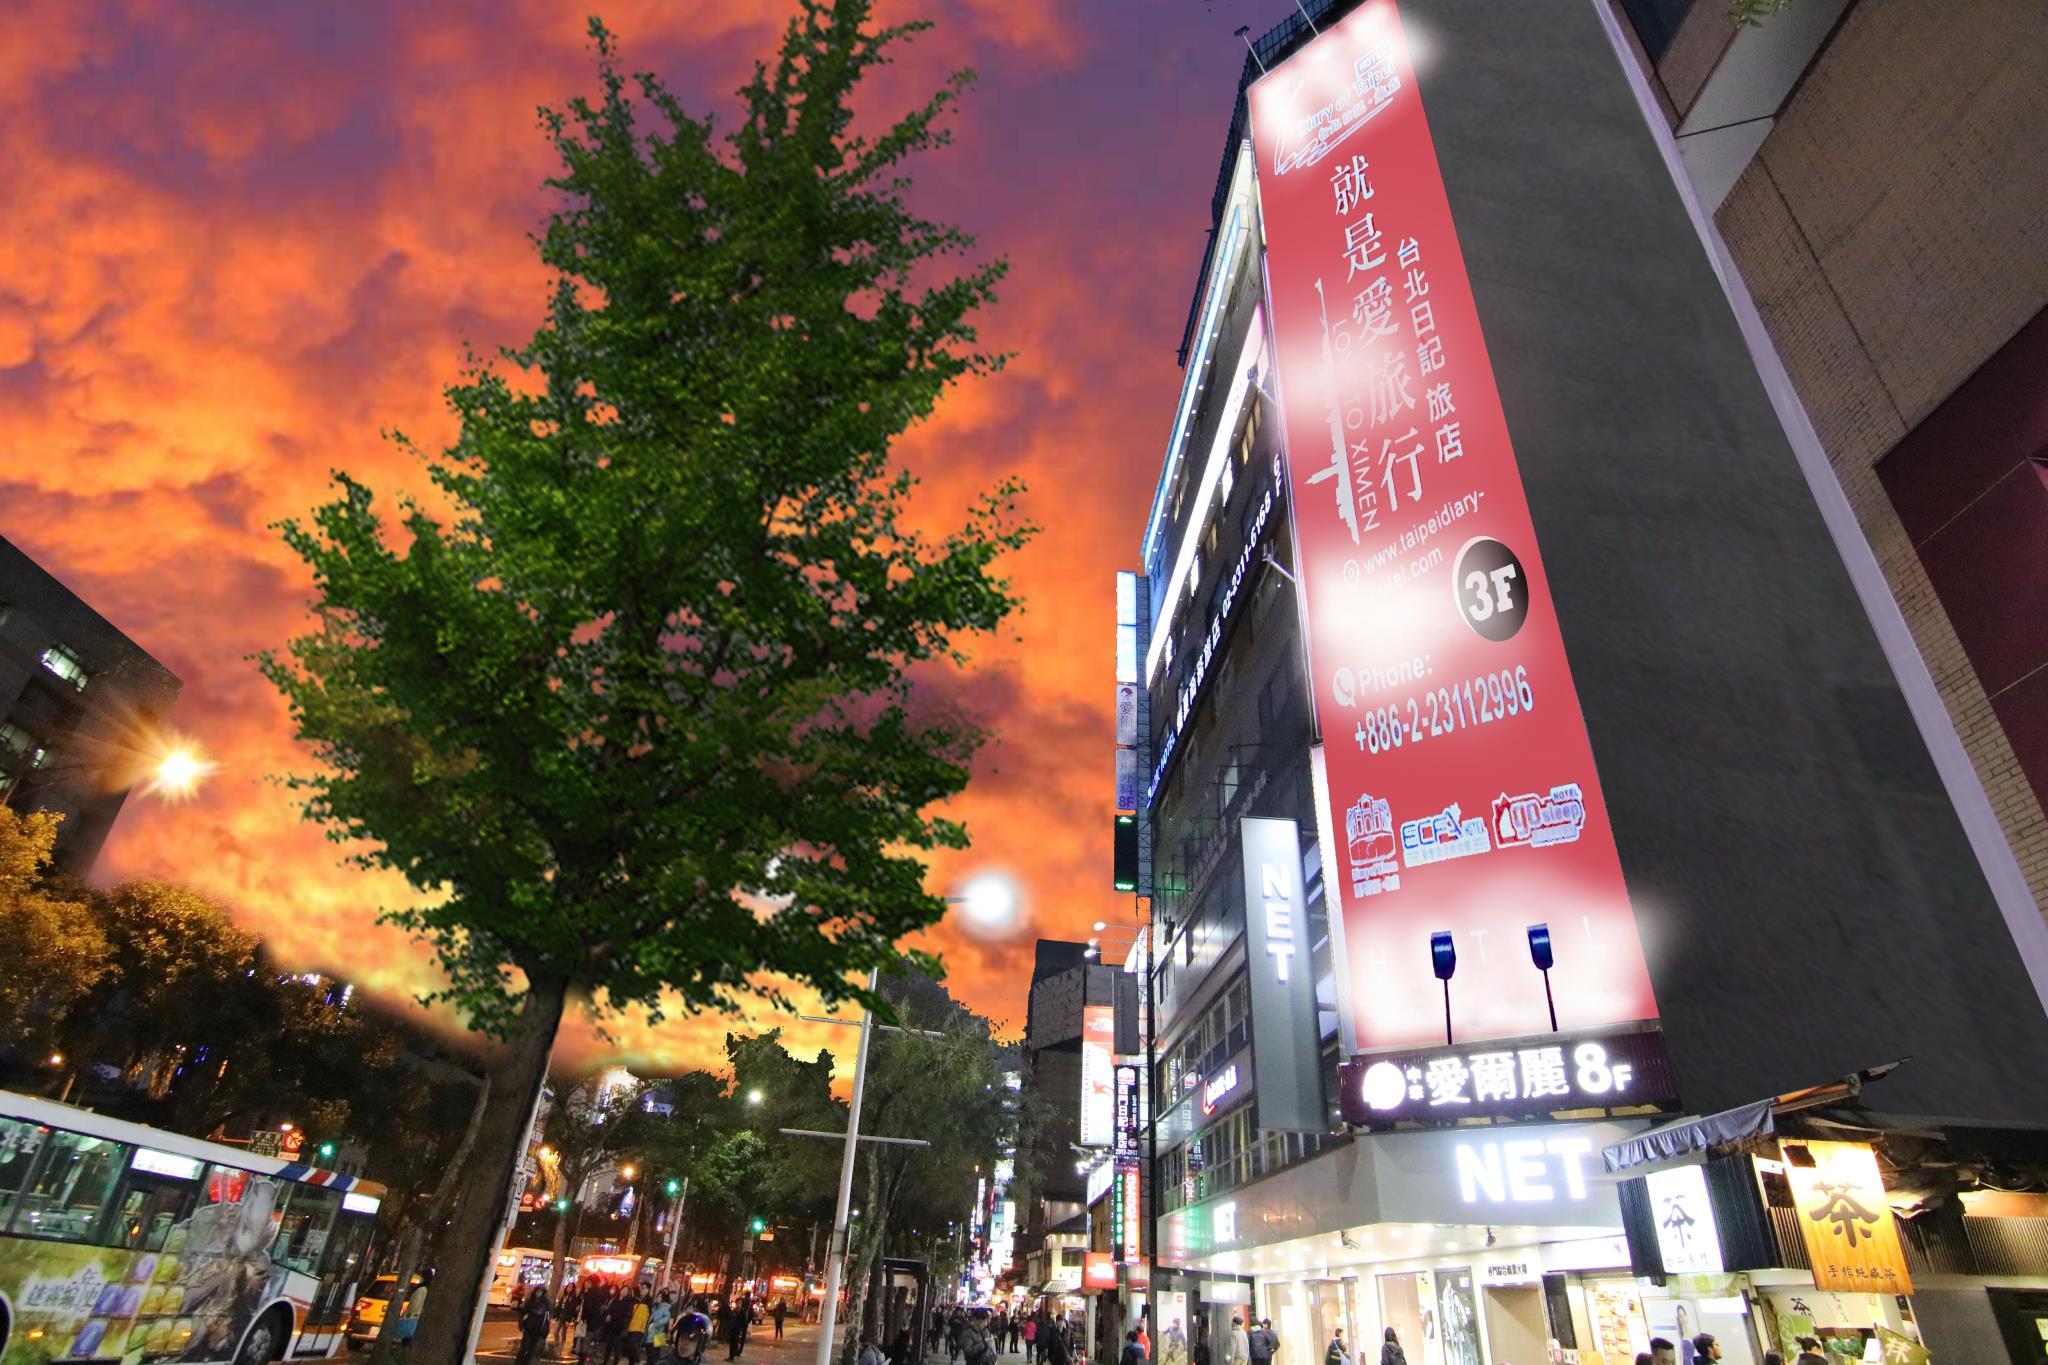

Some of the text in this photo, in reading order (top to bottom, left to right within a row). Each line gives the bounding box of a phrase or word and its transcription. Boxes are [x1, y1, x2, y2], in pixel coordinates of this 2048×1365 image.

[1330, 155, 1425, 512] 就是愛旅行
[1397, 236, 1464, 465] 台北日記旅店
[1351, 437, 1380, 532] XIMEN
[1363, 490, 1485, 575] www.taipeidiary-
[1465, 563, 1517, 622] 3F
[1355, 664, 1534, 754] +886-2-23112996
[1358, 654, 1433, 697] Phone:
[1402, 810, 1463, 849] ECFA
[1262, 863, 1294, 984] NET
[1426, 1046, 1570, 1106] 愛爾麗
[1574, 1042, 1633, 1095] 8F
[1456, 1138, 1592, 1203] NET
[1663, 1194, 1695, 1248] 茶
[1808, 1179, 1880, 1248] 茶
